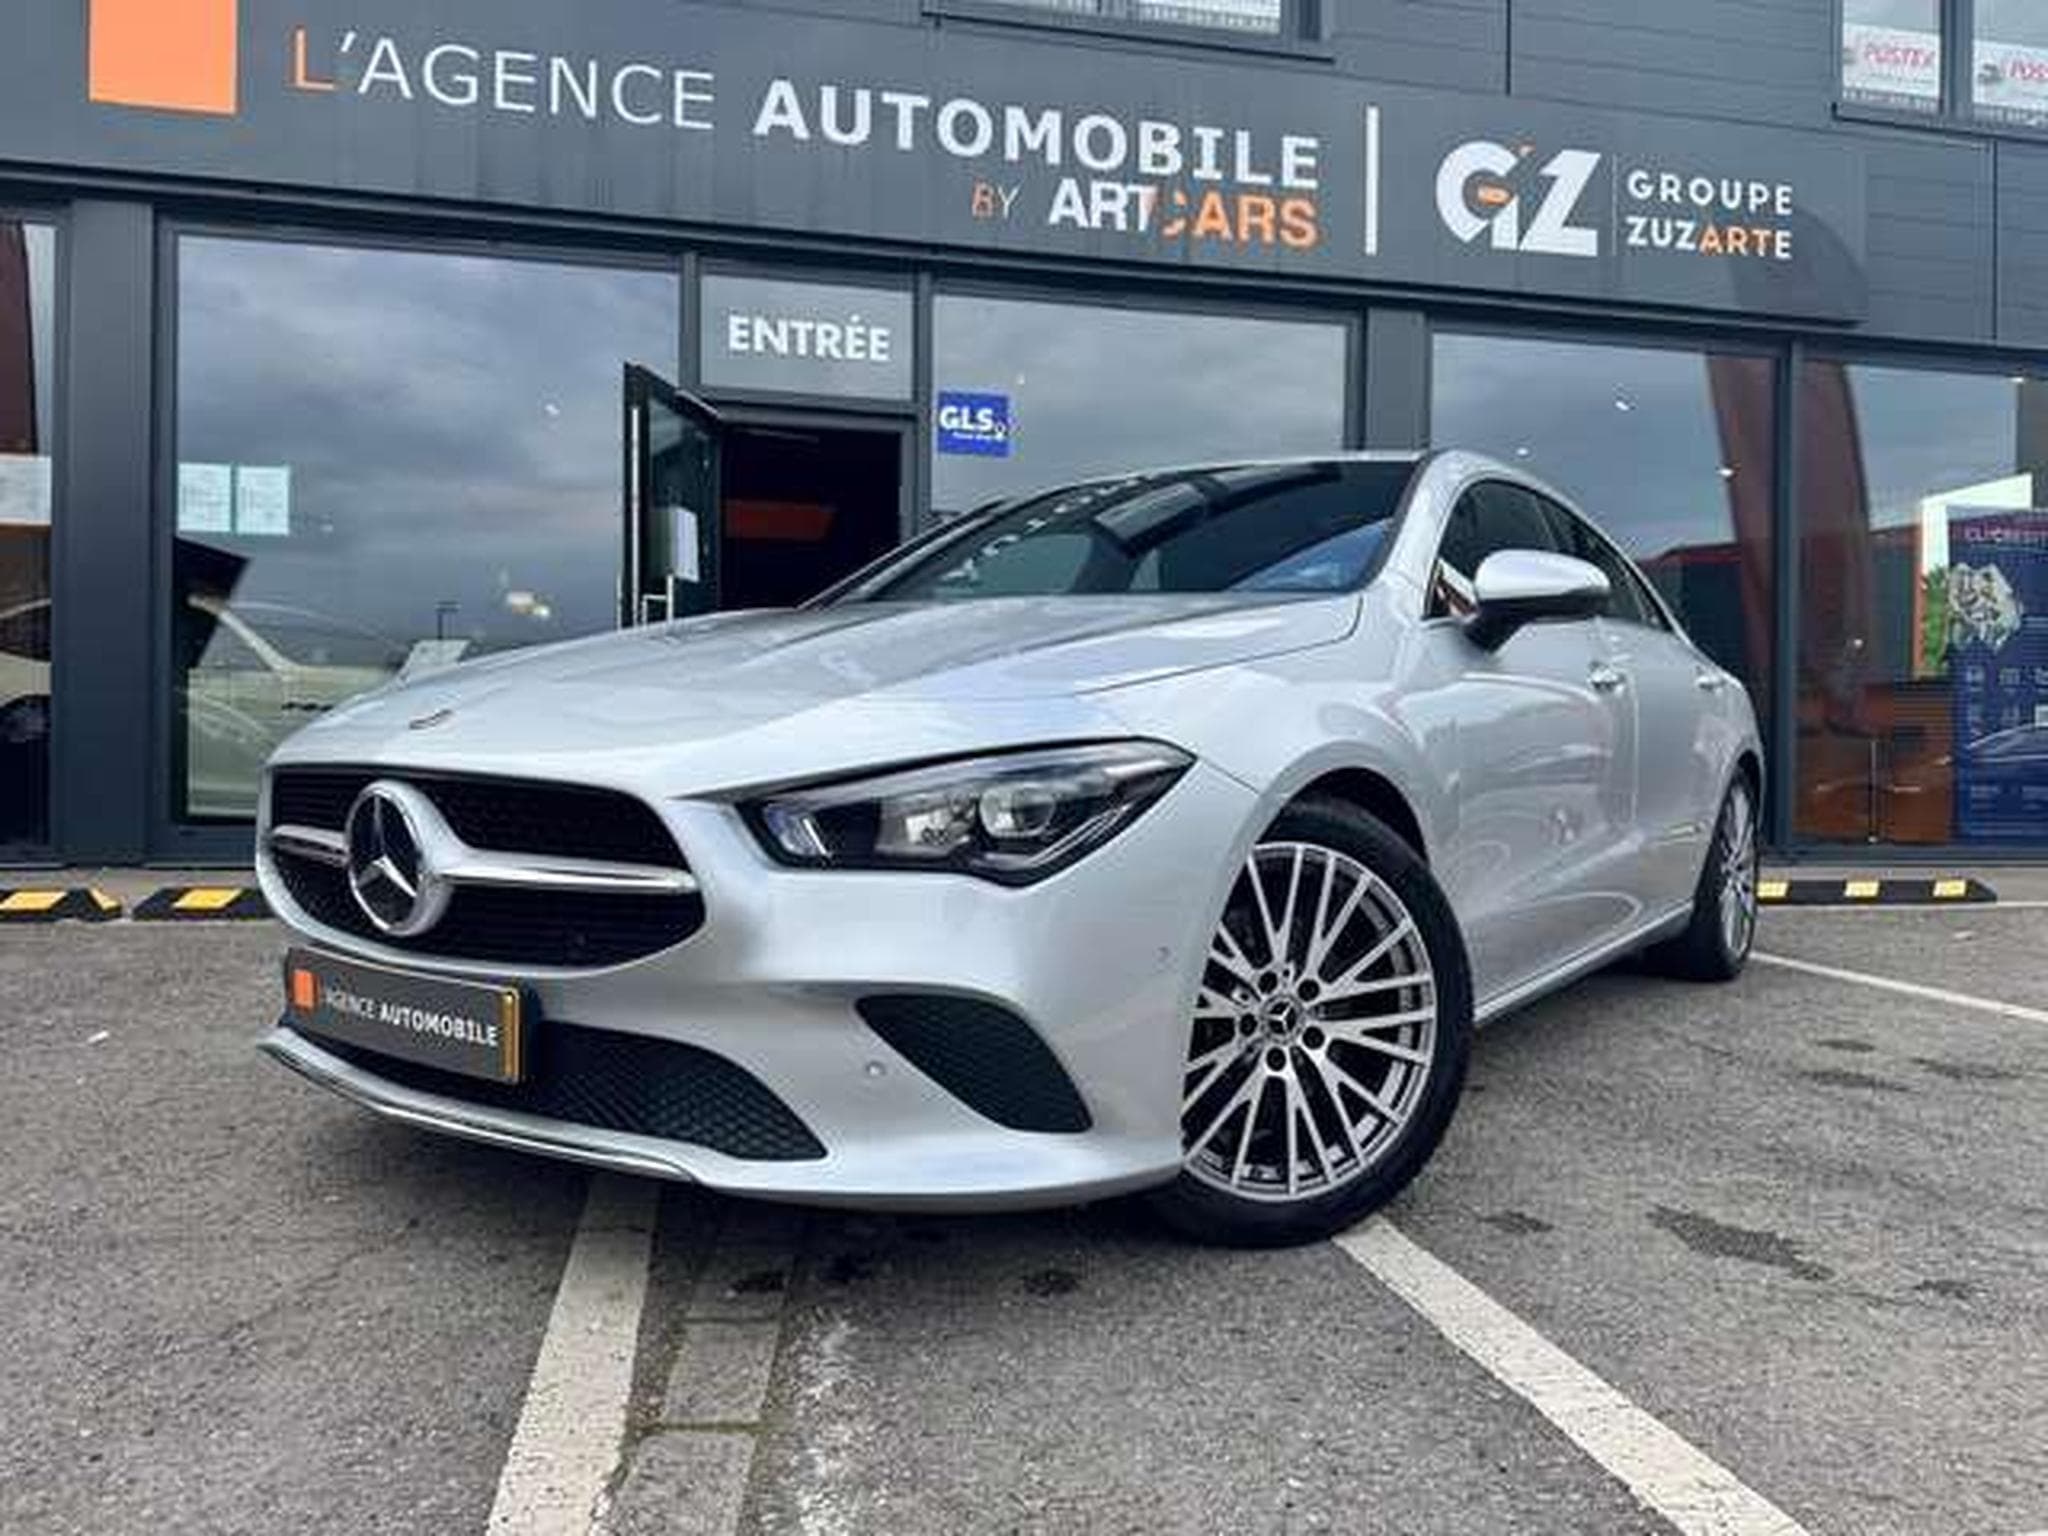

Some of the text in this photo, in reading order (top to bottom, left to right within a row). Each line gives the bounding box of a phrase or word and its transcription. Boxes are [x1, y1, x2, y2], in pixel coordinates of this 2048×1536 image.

[293, 28, 1319, 191] L'AGENCE AUTOMOBILE
[971, 180, 1019, 220] BY
[1626, 169, 1793, 215] GROUPE
[1624, 214, 1793, 260] ZUZARTE
[728, 313, 892, 362] ENTRÉE
[939, 404, 994, 431] GLS
[379, 1001, 499, 1047] AUTOMOBILE
